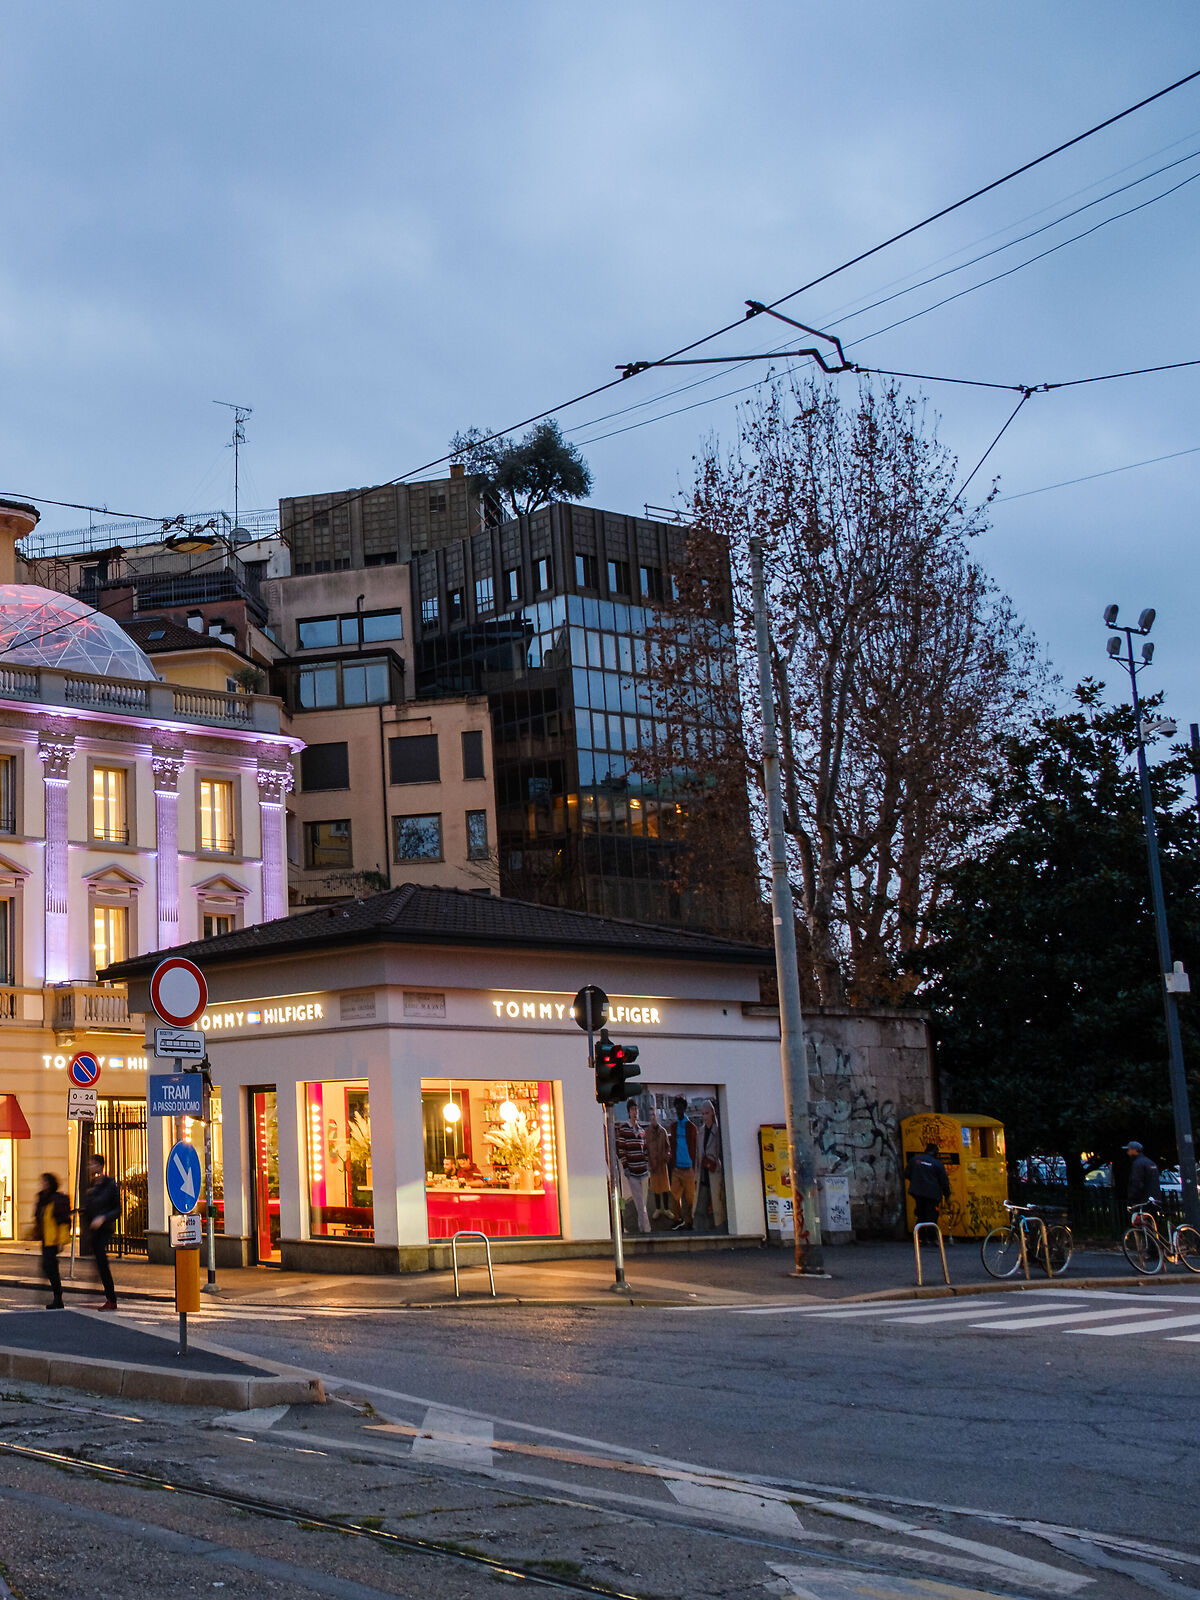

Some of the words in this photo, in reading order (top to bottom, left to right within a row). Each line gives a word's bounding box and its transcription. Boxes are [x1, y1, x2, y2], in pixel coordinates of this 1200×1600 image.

[264, 1003, 324, 1024] HILFIGER
[493, 1001, 565, 1019] TOMMY
[43, 1055, 106, 1068] TOY
[162, 1085, 190, 1100] TRAM
[152, 1102, 158, 1111] A
[158, 1101, 176, 1111] PASSO
[177, 1101, 200, 1111] D'UOMO
